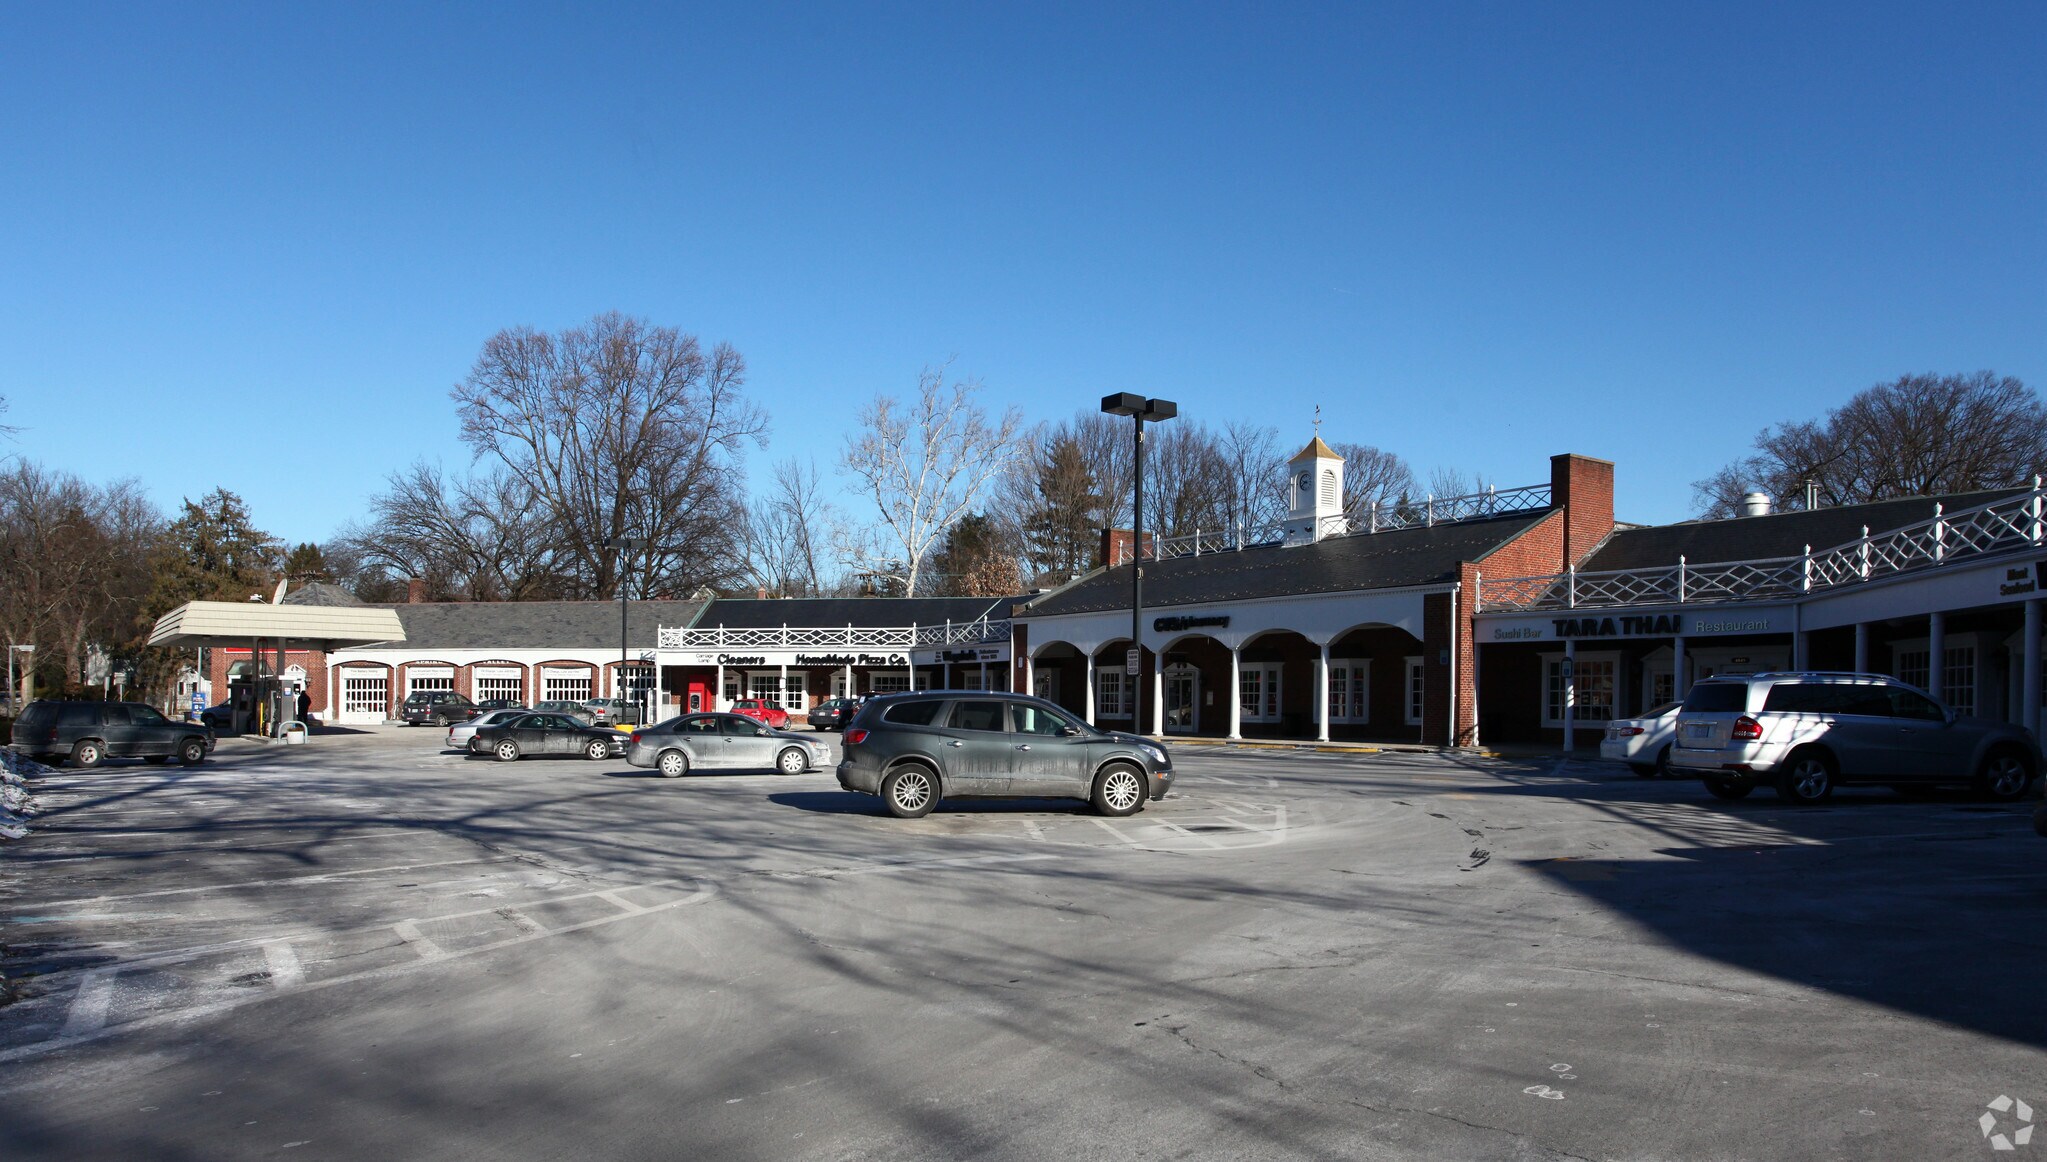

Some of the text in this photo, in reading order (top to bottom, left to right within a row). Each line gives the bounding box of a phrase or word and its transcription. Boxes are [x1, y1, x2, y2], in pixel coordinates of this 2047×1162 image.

[1552, 615, 1681, 637] TARA THAI
[1696, 618, 1768, 633] Restaurant
[1494, 628, 1543, 640] Sushi Bar
[717, 653, 766, 665] Cleaners
[796, 653, 907, 665] HomeMade Pizza Co.
